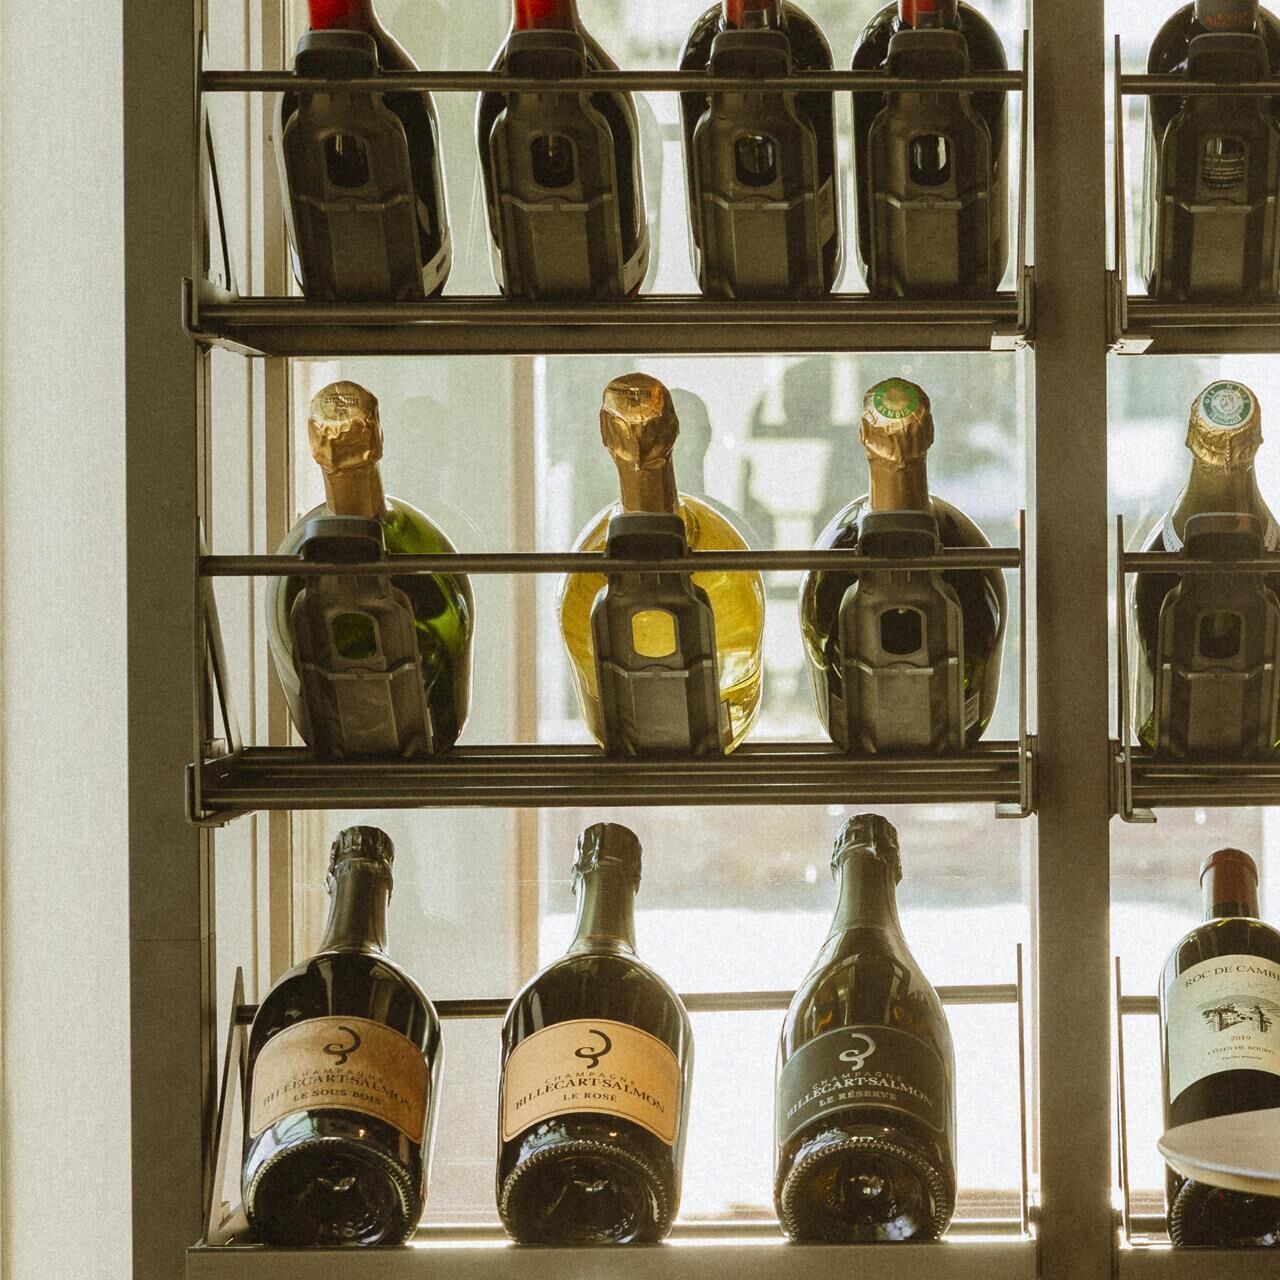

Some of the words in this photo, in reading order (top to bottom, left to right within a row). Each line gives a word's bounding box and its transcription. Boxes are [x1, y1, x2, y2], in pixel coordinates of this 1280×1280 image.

[1185, 970, 1211, 987] ROC
[1214, 965, 1234, 975] DE
[545, 1071, 636, 1086] CHAMPAGNE
[294, 1092, 306, 1102] LE
[312, 1088, 348, 1097] SOUS
[352, 1091, 383, 1105] BOIS
[515, 1077, 665, 1113] BILLECART-SALMON
[563, 1093, 579, 1102] LE
[584, 1092, 617, 1102] ROSÉ
[819, 1096, 835, 1107] LE
[838, 1089, 898, 1101] RÉSERVE
